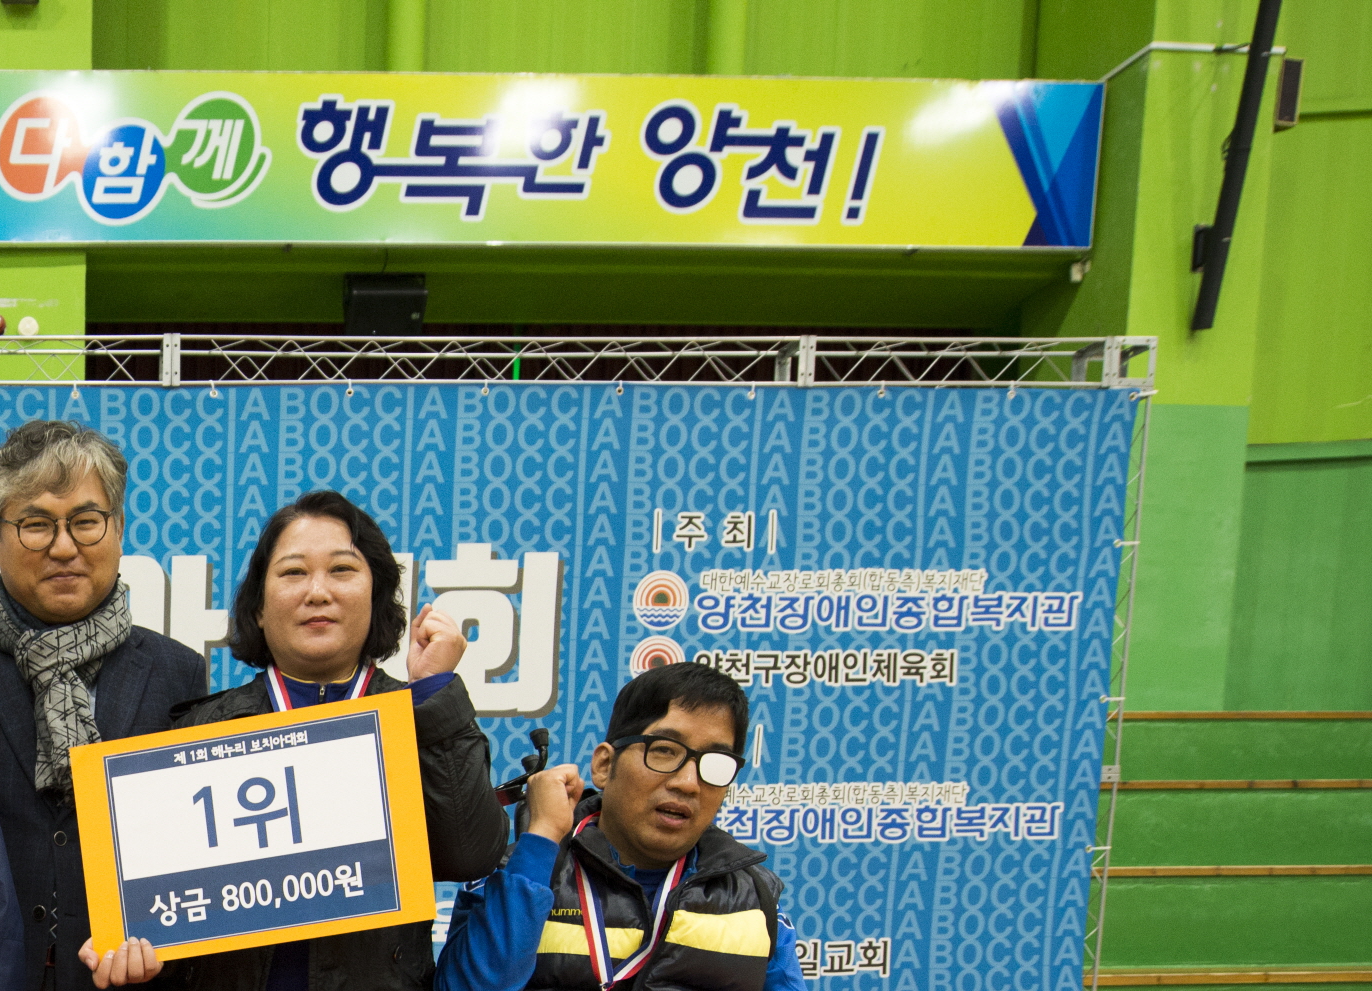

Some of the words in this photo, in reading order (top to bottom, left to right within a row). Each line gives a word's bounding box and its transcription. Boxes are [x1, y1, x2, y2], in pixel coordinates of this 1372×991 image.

[297, 94, 612, 222] 행복한
[696, 593, 1081, 632] 양천장애인종합복지관
[173, 751, 187, 764] 제
[190, 747, 208, 761] 1회
[211, 740, 247, 758] 해누리
[192, 765, 303, 849] 1위
[713, 805, 1061, 841] 천장애인종합복지관
[149, 887, 212, 927] 상금
[221, 861, 364, 914] 800,000원
